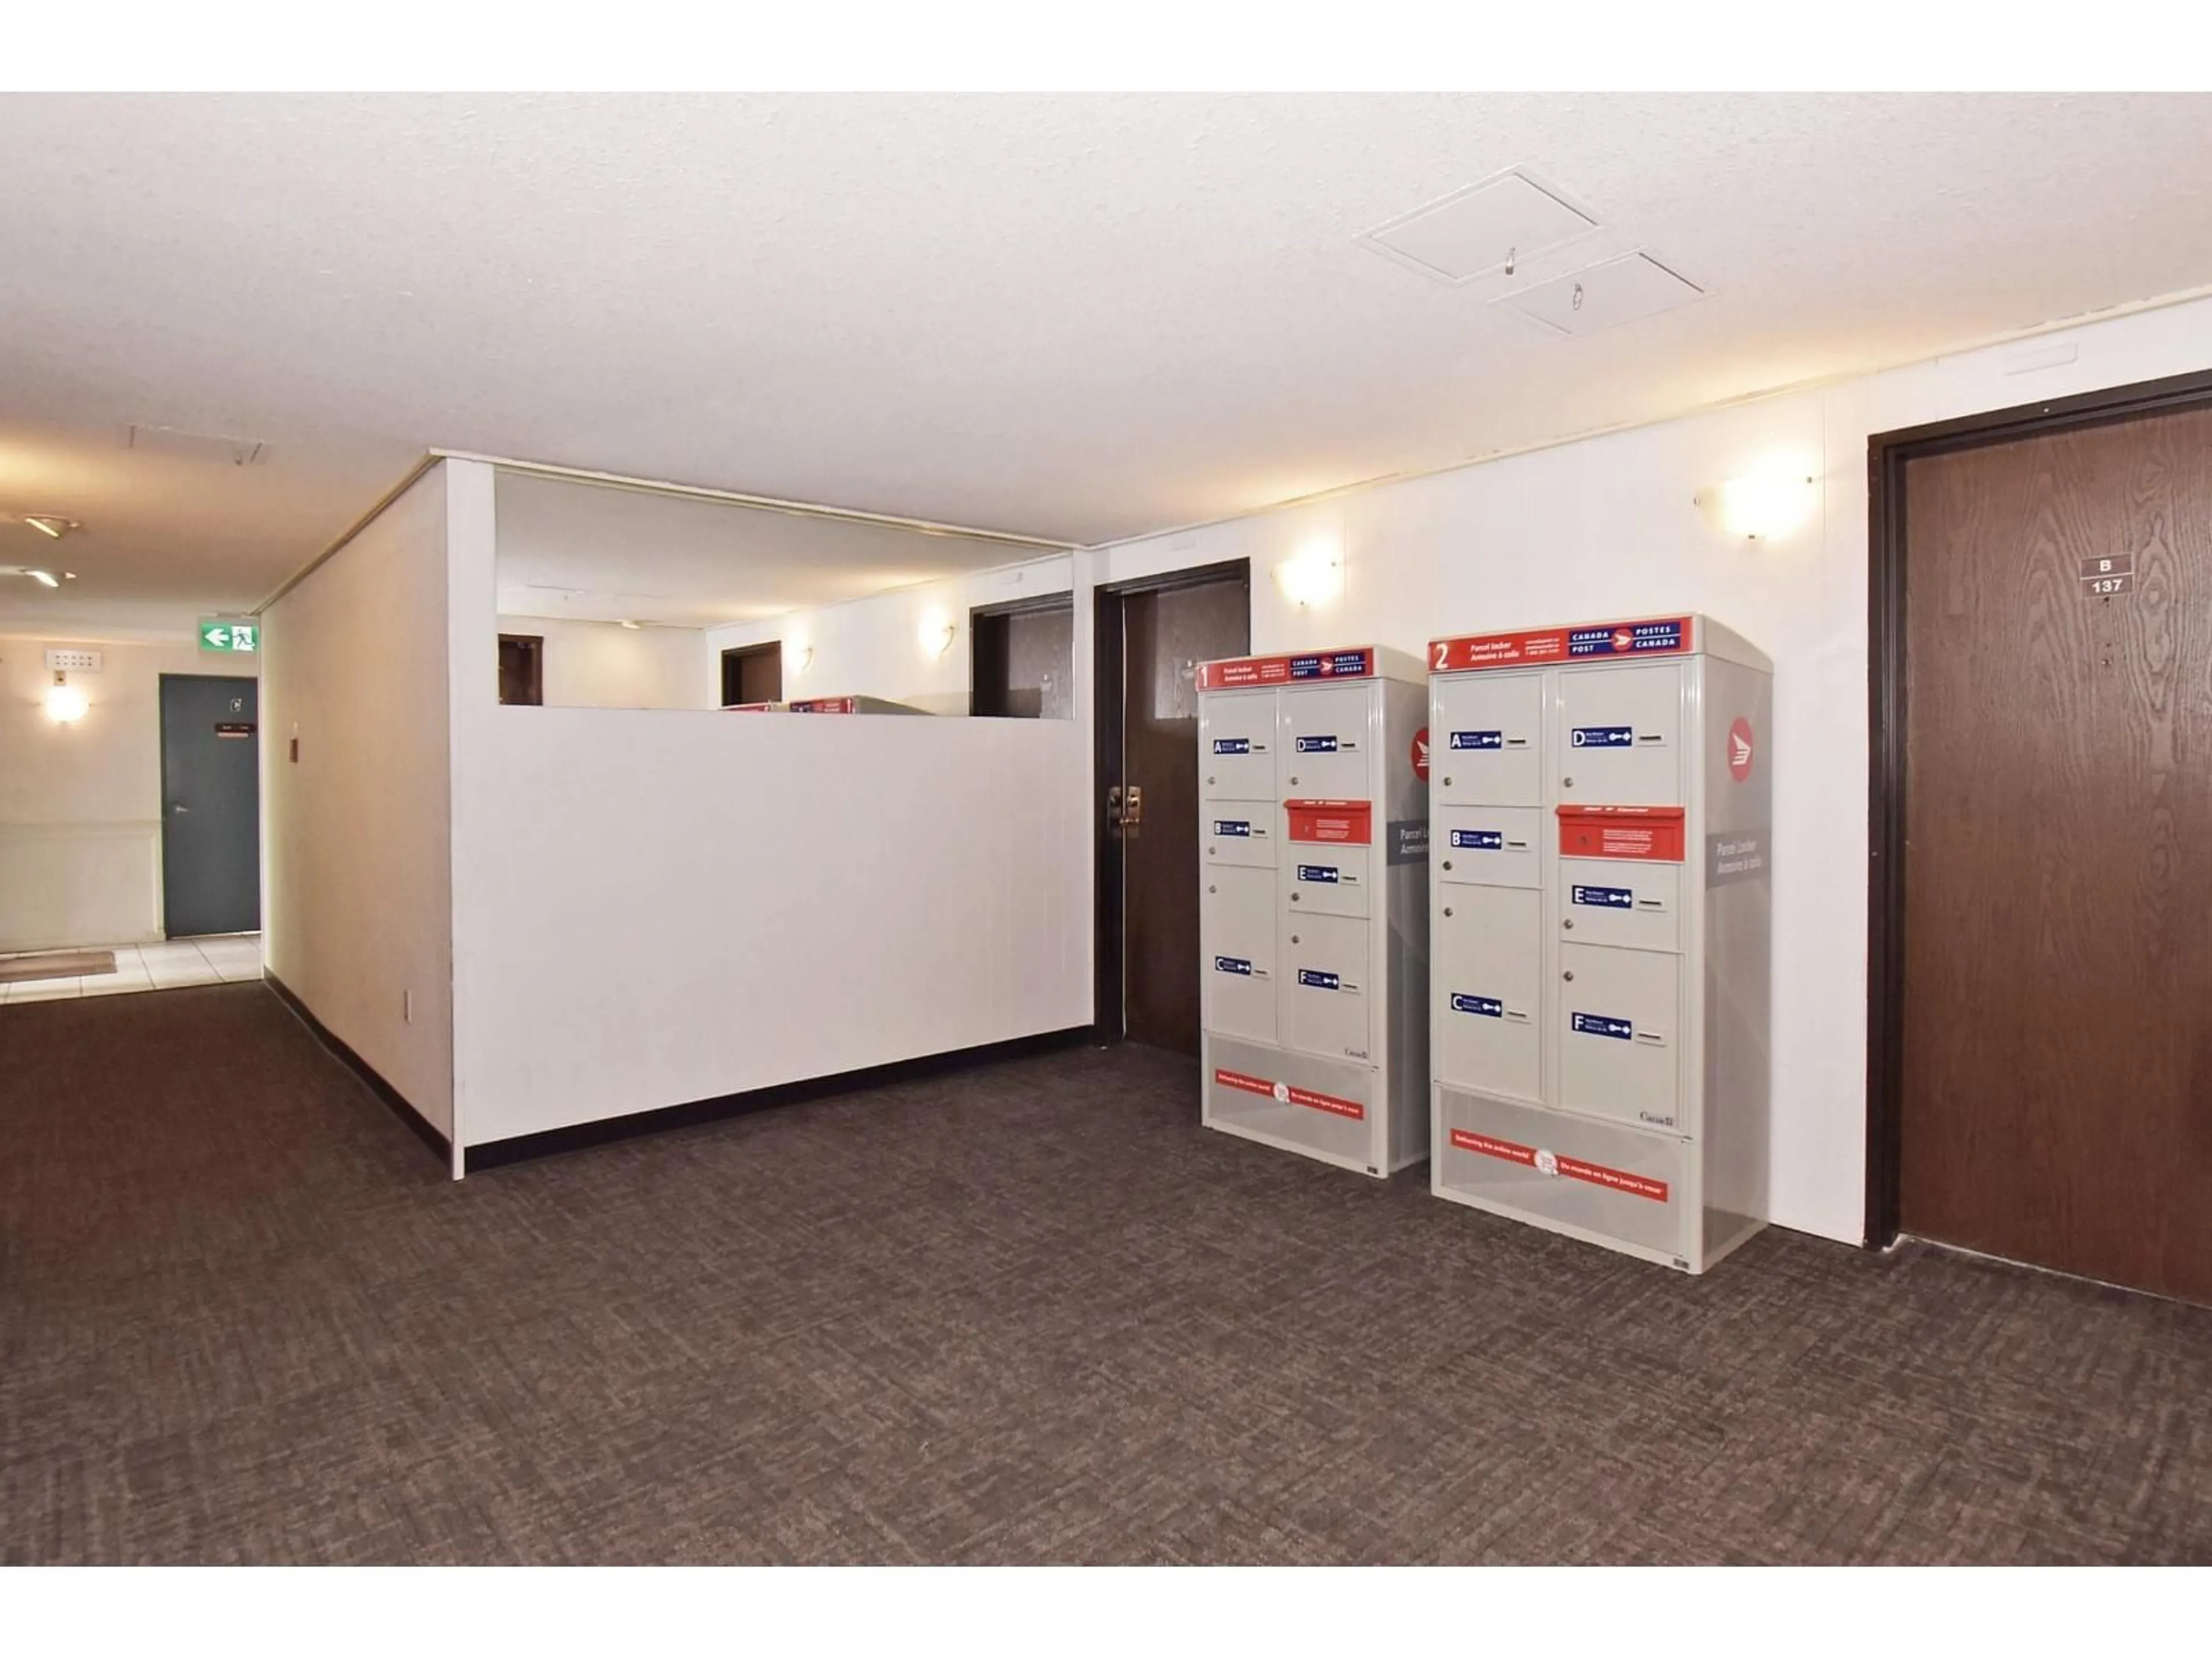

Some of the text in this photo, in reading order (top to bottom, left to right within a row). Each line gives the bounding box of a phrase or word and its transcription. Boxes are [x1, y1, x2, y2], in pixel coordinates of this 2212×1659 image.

[2100, 559, 2112, 572] B
[2092, 578, 2123, 594] 137
[1572, 631, 1609, 641] CANADA
[1635, 626, 1671, 635] POSTES
[1572, 645, 1594, 653] POST
[1635, 638, 1676, 649] CANADA
[1435, 642, 1449, 670] 2
[1200, 665, 1208, 687] 1
[1451, 733, 1462, 748] A
[1573, 730, 1585, 746] D
[1215, 741, 1222, 753] A
[1298, 739, 1306, 752] D
[1215, 822, 1221, 834] B
[1452, 832, 1461, 846] B
[1300, 866, 1306, 880] E
[1574, 888, 1585, 903] E
[1216, 958, 1224, 971] C
[1301, 972, 1307, 983] F
[1452, 995, 1463, 1010] C
[1574, 1015, 1584, 1030] F
